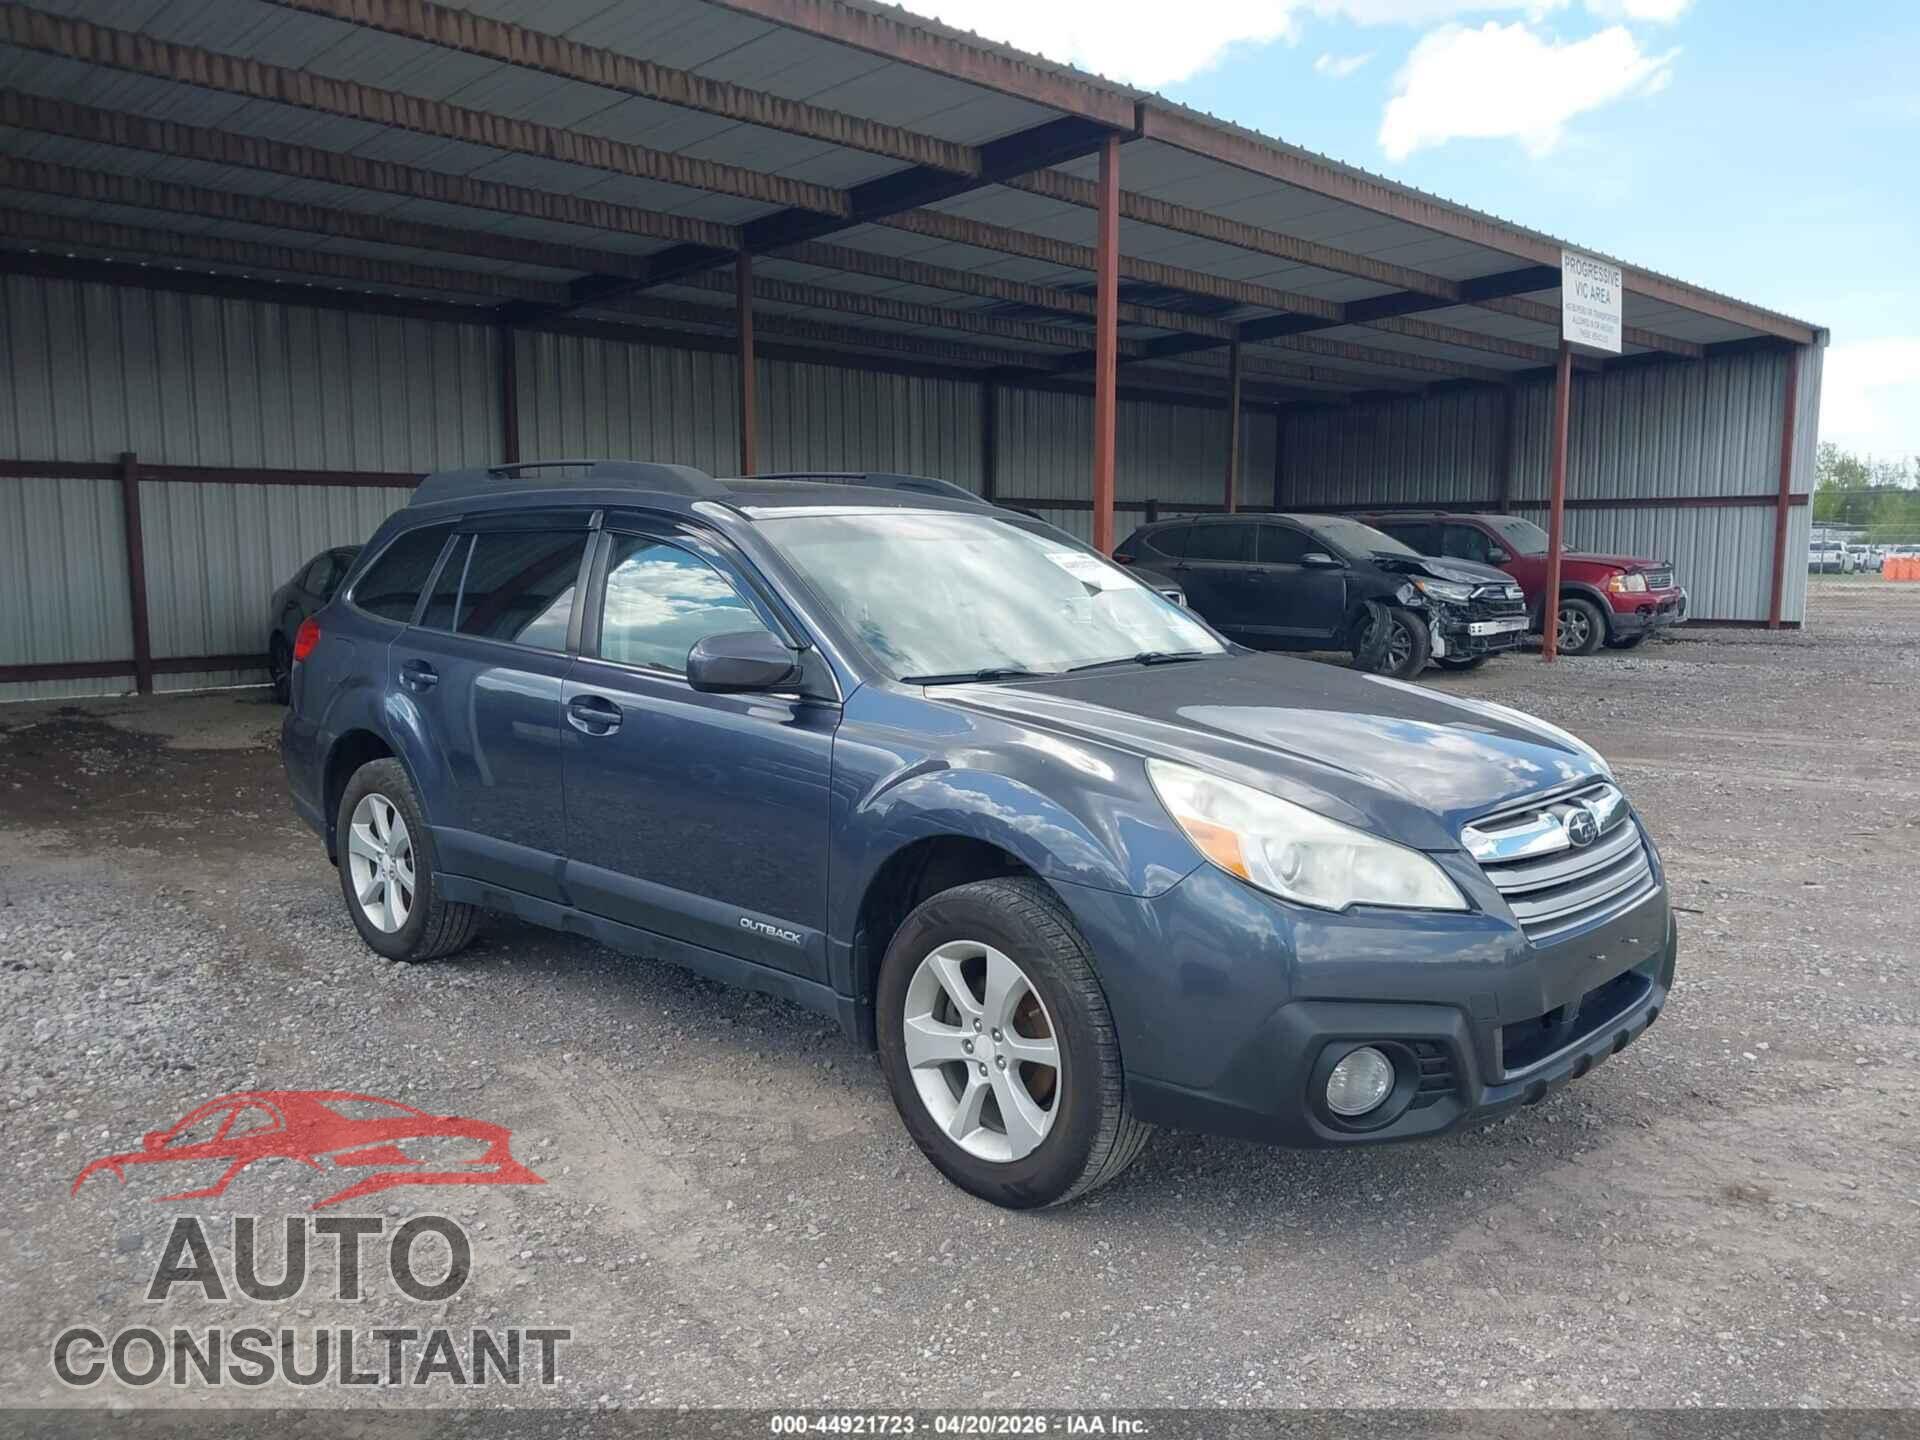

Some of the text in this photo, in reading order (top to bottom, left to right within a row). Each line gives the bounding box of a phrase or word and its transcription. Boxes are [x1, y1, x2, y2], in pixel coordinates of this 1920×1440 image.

[1565, 255, 1620, 288] PROGRESSIVE
[1576, 280, 1611, 305] VIC AREA
[740, 918, 801, 944] OUTBACK
